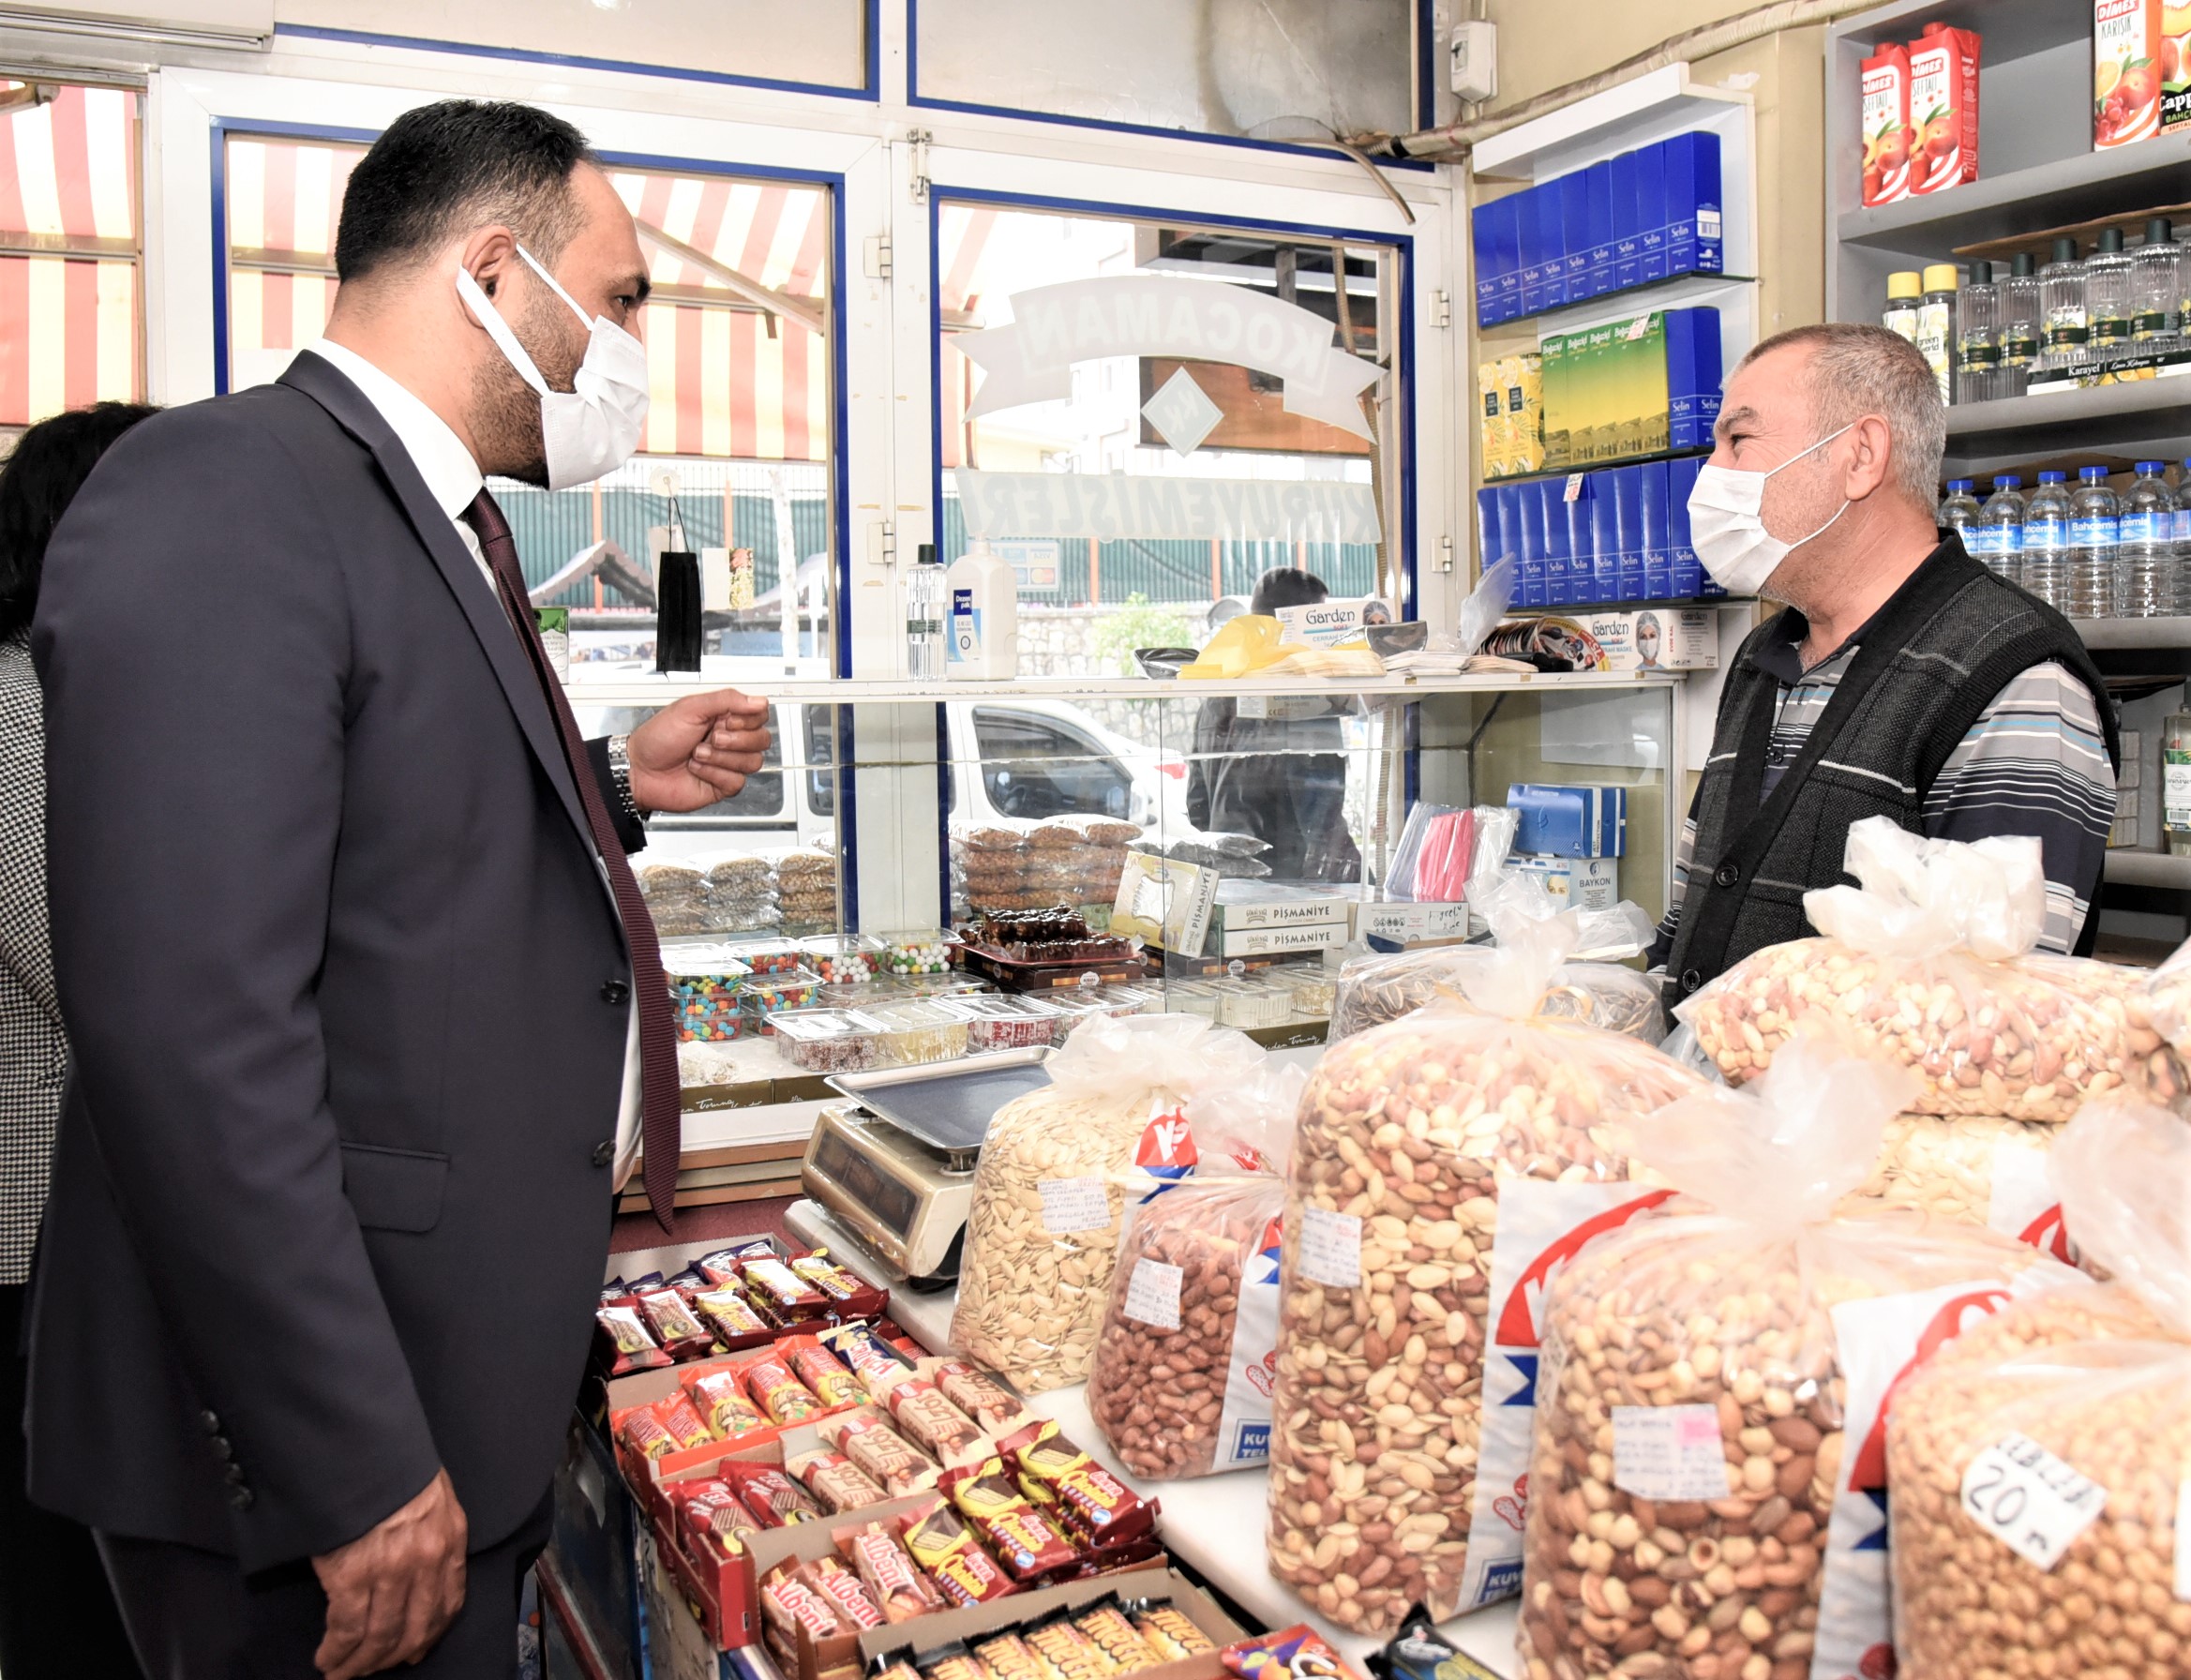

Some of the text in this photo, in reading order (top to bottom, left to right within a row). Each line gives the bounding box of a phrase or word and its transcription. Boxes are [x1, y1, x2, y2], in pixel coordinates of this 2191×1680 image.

[2101, 15, 2132, 39] KARIŞIK
[2165, 109, 2191, 123] BAHÇ
[2068, 363, 2100, 377] Karayel
[1673, 399, 1690, 412] Selin
[1306, 608, 1356, 624] Garden
[1592, 619, 1629, 637] Garden
[1580, 878, 1611, 888] BAYKON
[1192, 872, 1211, 929] PİŞMANİYE
[1273, 905, 1329, 920] PİŞMANİYE
[1275, 931, 1330, 946] PİŞMANİYE
[849, 1342, 900, 1377] CRUNCH
[1968, 1463, 2027, 1526] 20
[855, 1532, 904, 1591] Albeni
[1031, 1626, 1103, 1680] metr
